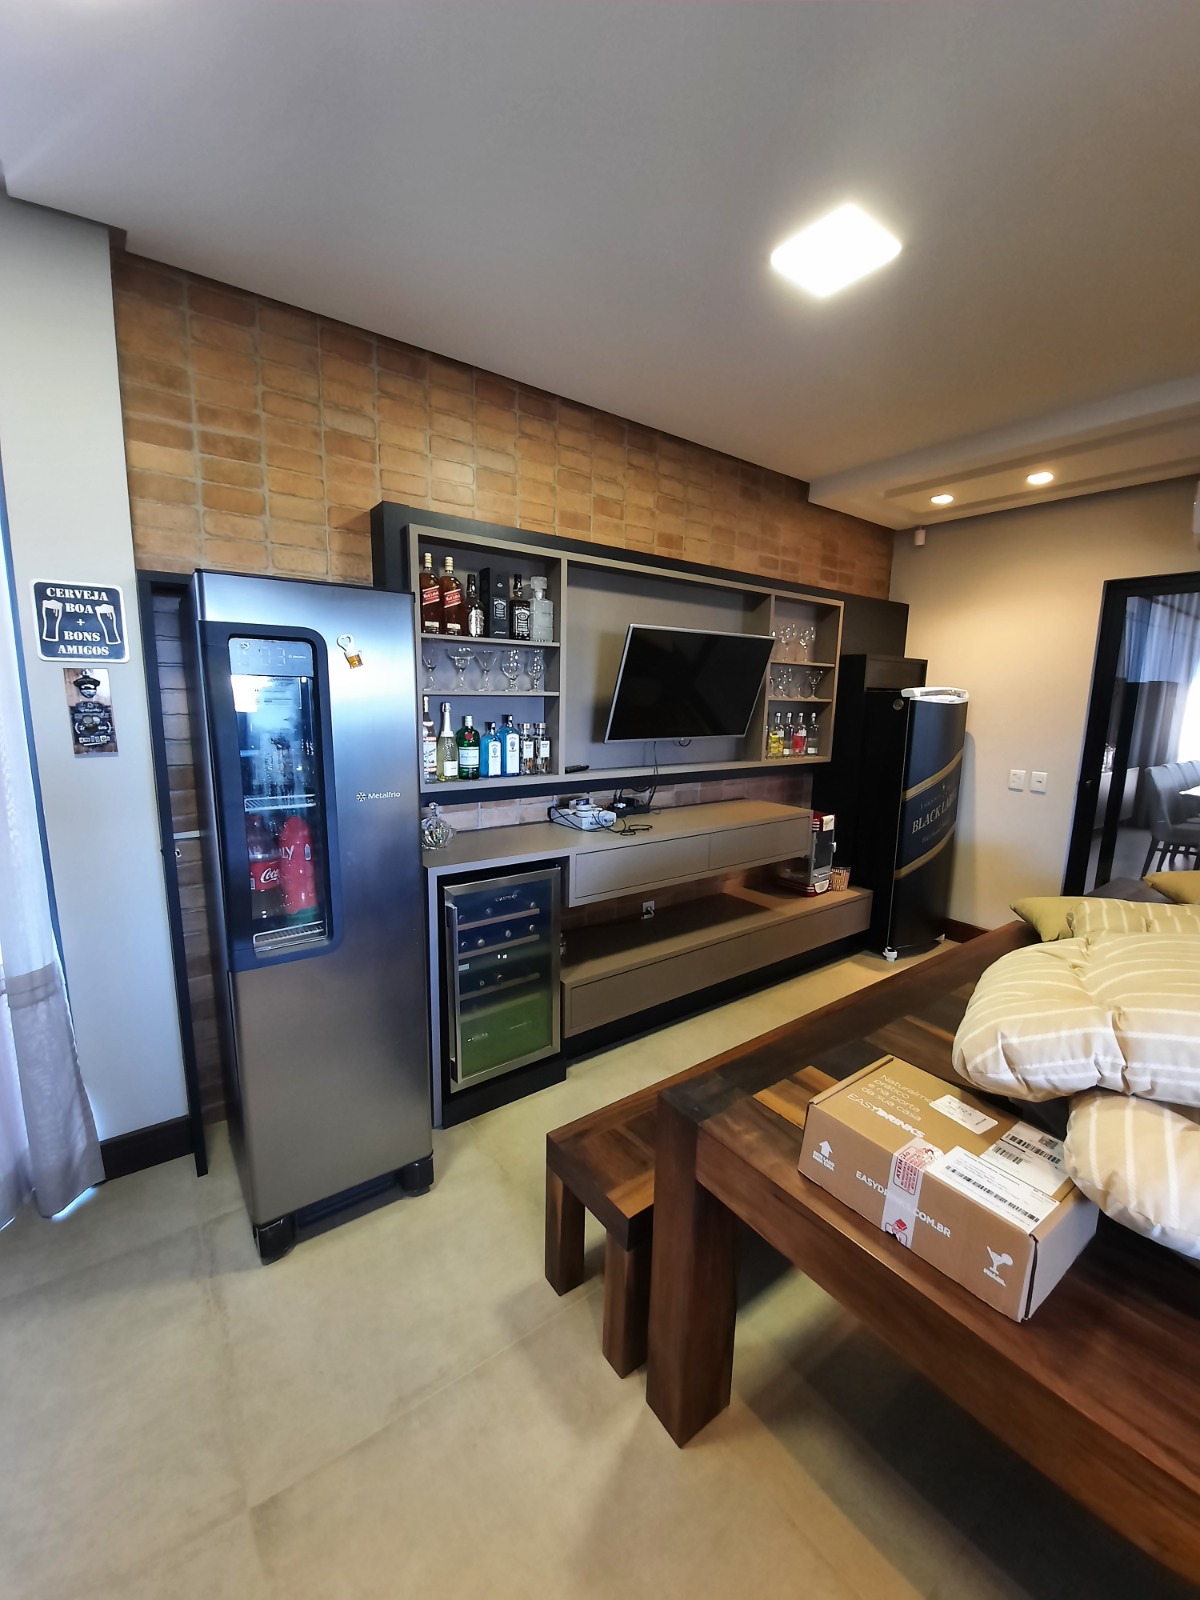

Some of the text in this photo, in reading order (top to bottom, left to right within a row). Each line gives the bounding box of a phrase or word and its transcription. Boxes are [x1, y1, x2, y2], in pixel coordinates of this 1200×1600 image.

[46, 587, 108, 601] CERVEJA
[65, 602, 94, 614] BOA
[63, 630, 101, 642] BONS
[57, 644, 110, 656] AMIGOS
[367, 791, 401, 799] Metalfrio
[911, 804, 941, 834] BLACK
[876, 1095, 895, 1107] sua
[896, 1105, 922, 1121] casa
[890, 1095, 921, 1113] porta
